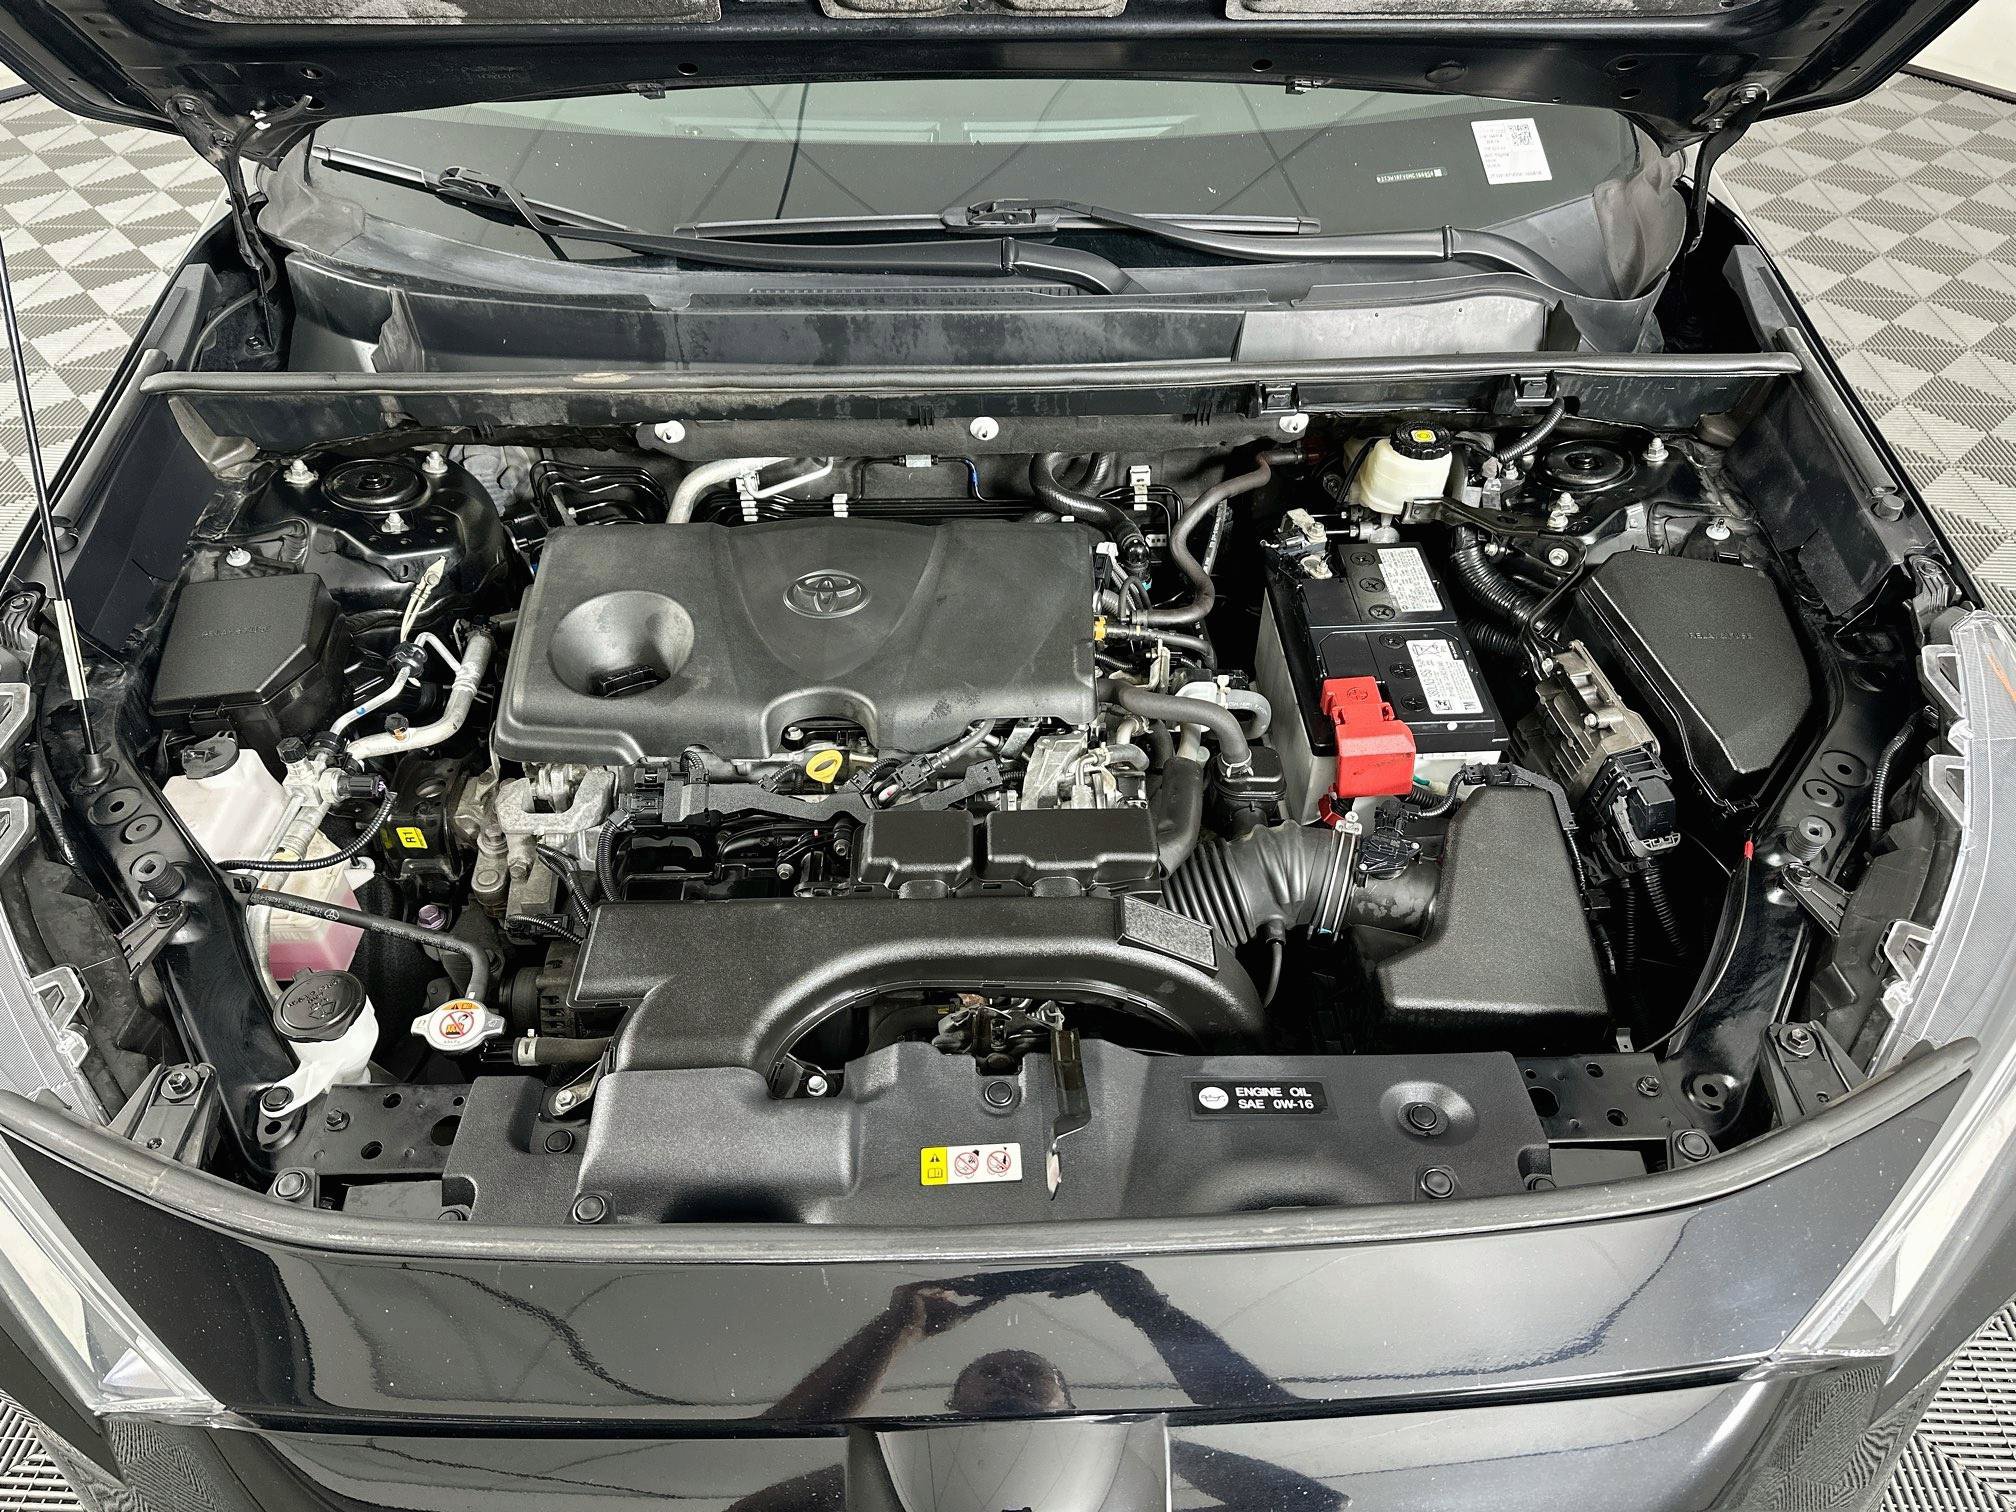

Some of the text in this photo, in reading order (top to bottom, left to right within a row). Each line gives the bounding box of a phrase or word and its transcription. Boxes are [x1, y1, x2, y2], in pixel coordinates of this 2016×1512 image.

[1234, 1086, 1312, 1097] ENGINE OIL
[1237, 1099, 1315, 1110] SAE 0W-16
